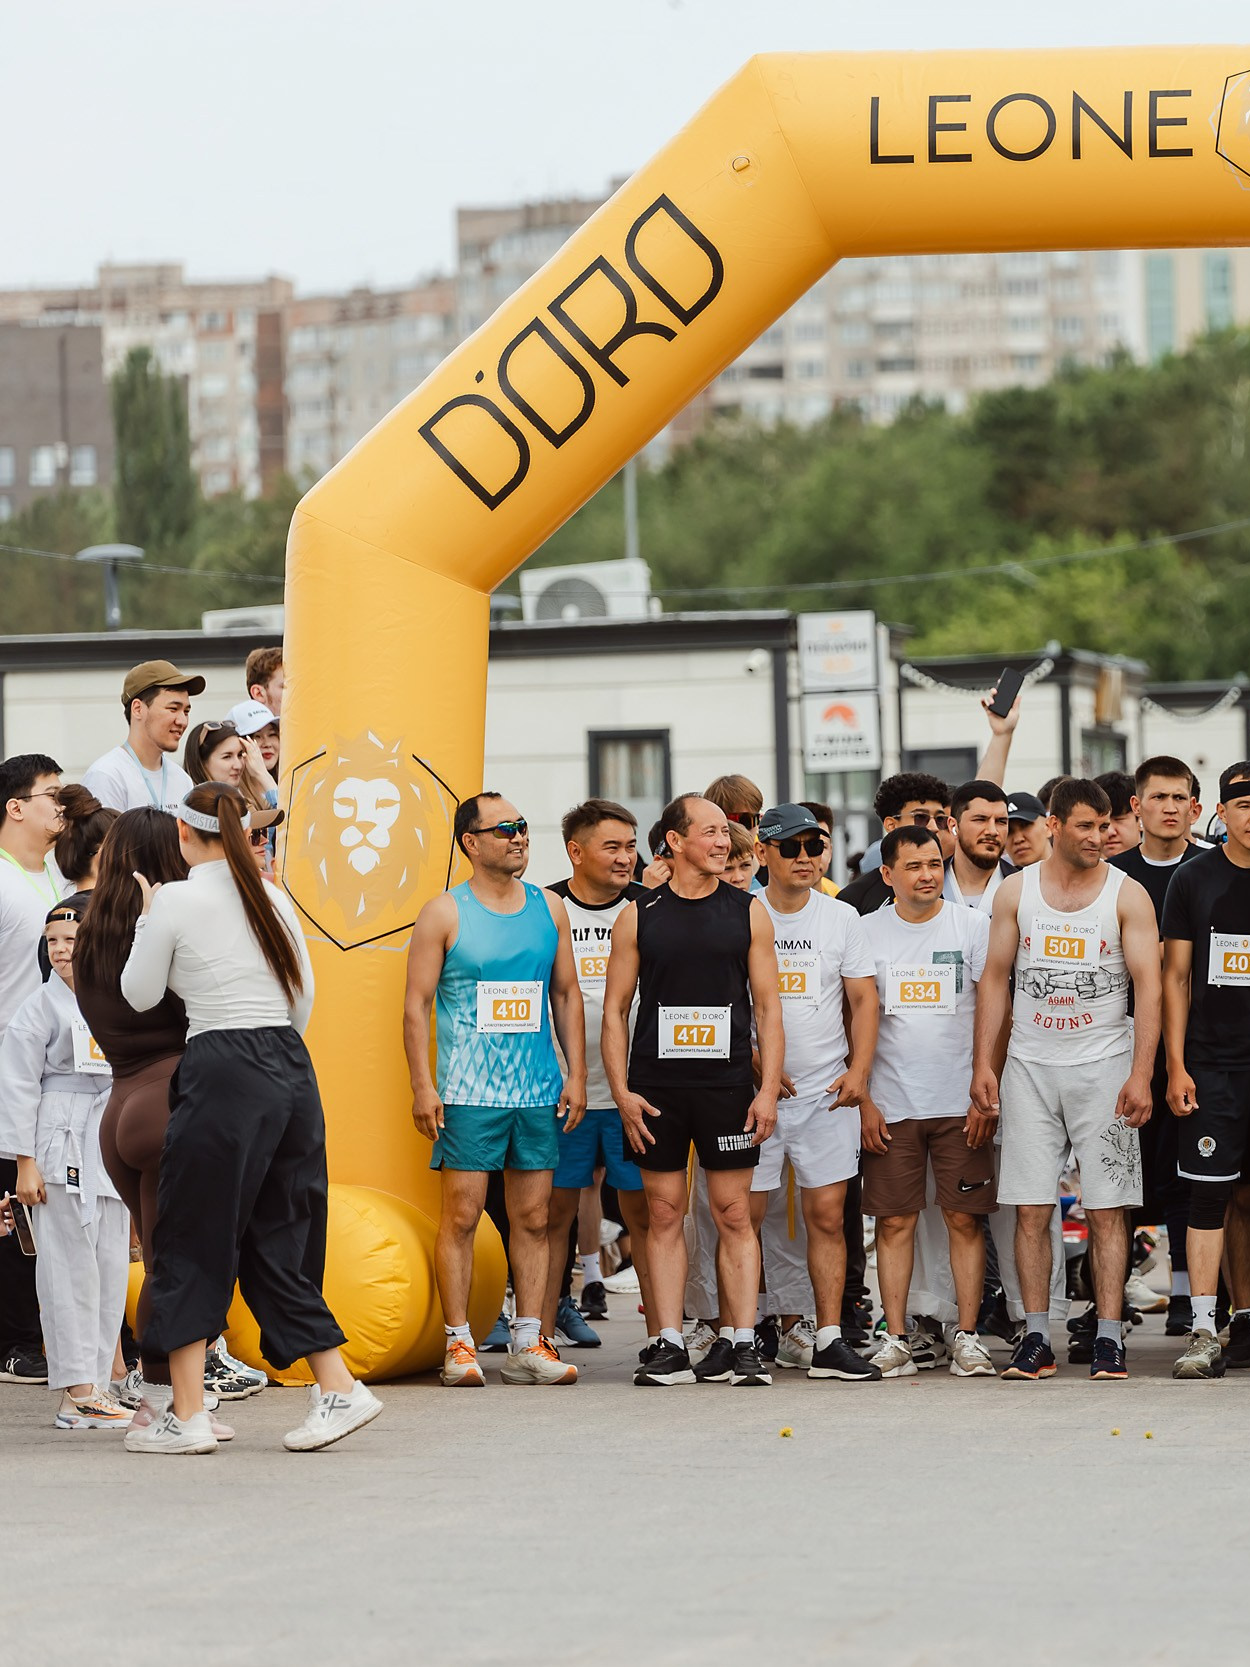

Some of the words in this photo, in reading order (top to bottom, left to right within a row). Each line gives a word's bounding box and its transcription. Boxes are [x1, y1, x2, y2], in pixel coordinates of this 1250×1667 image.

[869, 89, 1194, 165] LEONE
[185, 810, 220, 830] CHRISTIA
[1037, 924, 1061, 932] LEONE
[574, 946, 596, 954] EONE
[1048, 938, 1080, 957] 501
[1216, 940, 1239, 948] LEONE
[584, 958, 607, 975] 33
[483, 987, 509, 995] LEONE
[778, 974, 802, 991] 12
[903, 983, 937, 1000] 334
[1048, 996, 1075, 1005] AGAIN
[496, 1001, 527, 1018] 410
[1033, 1012, 1094, 1030] ROUND
[677, 1026, 712, 1044] 417
[717, 1132, 756, 1152] ULTIMAT
